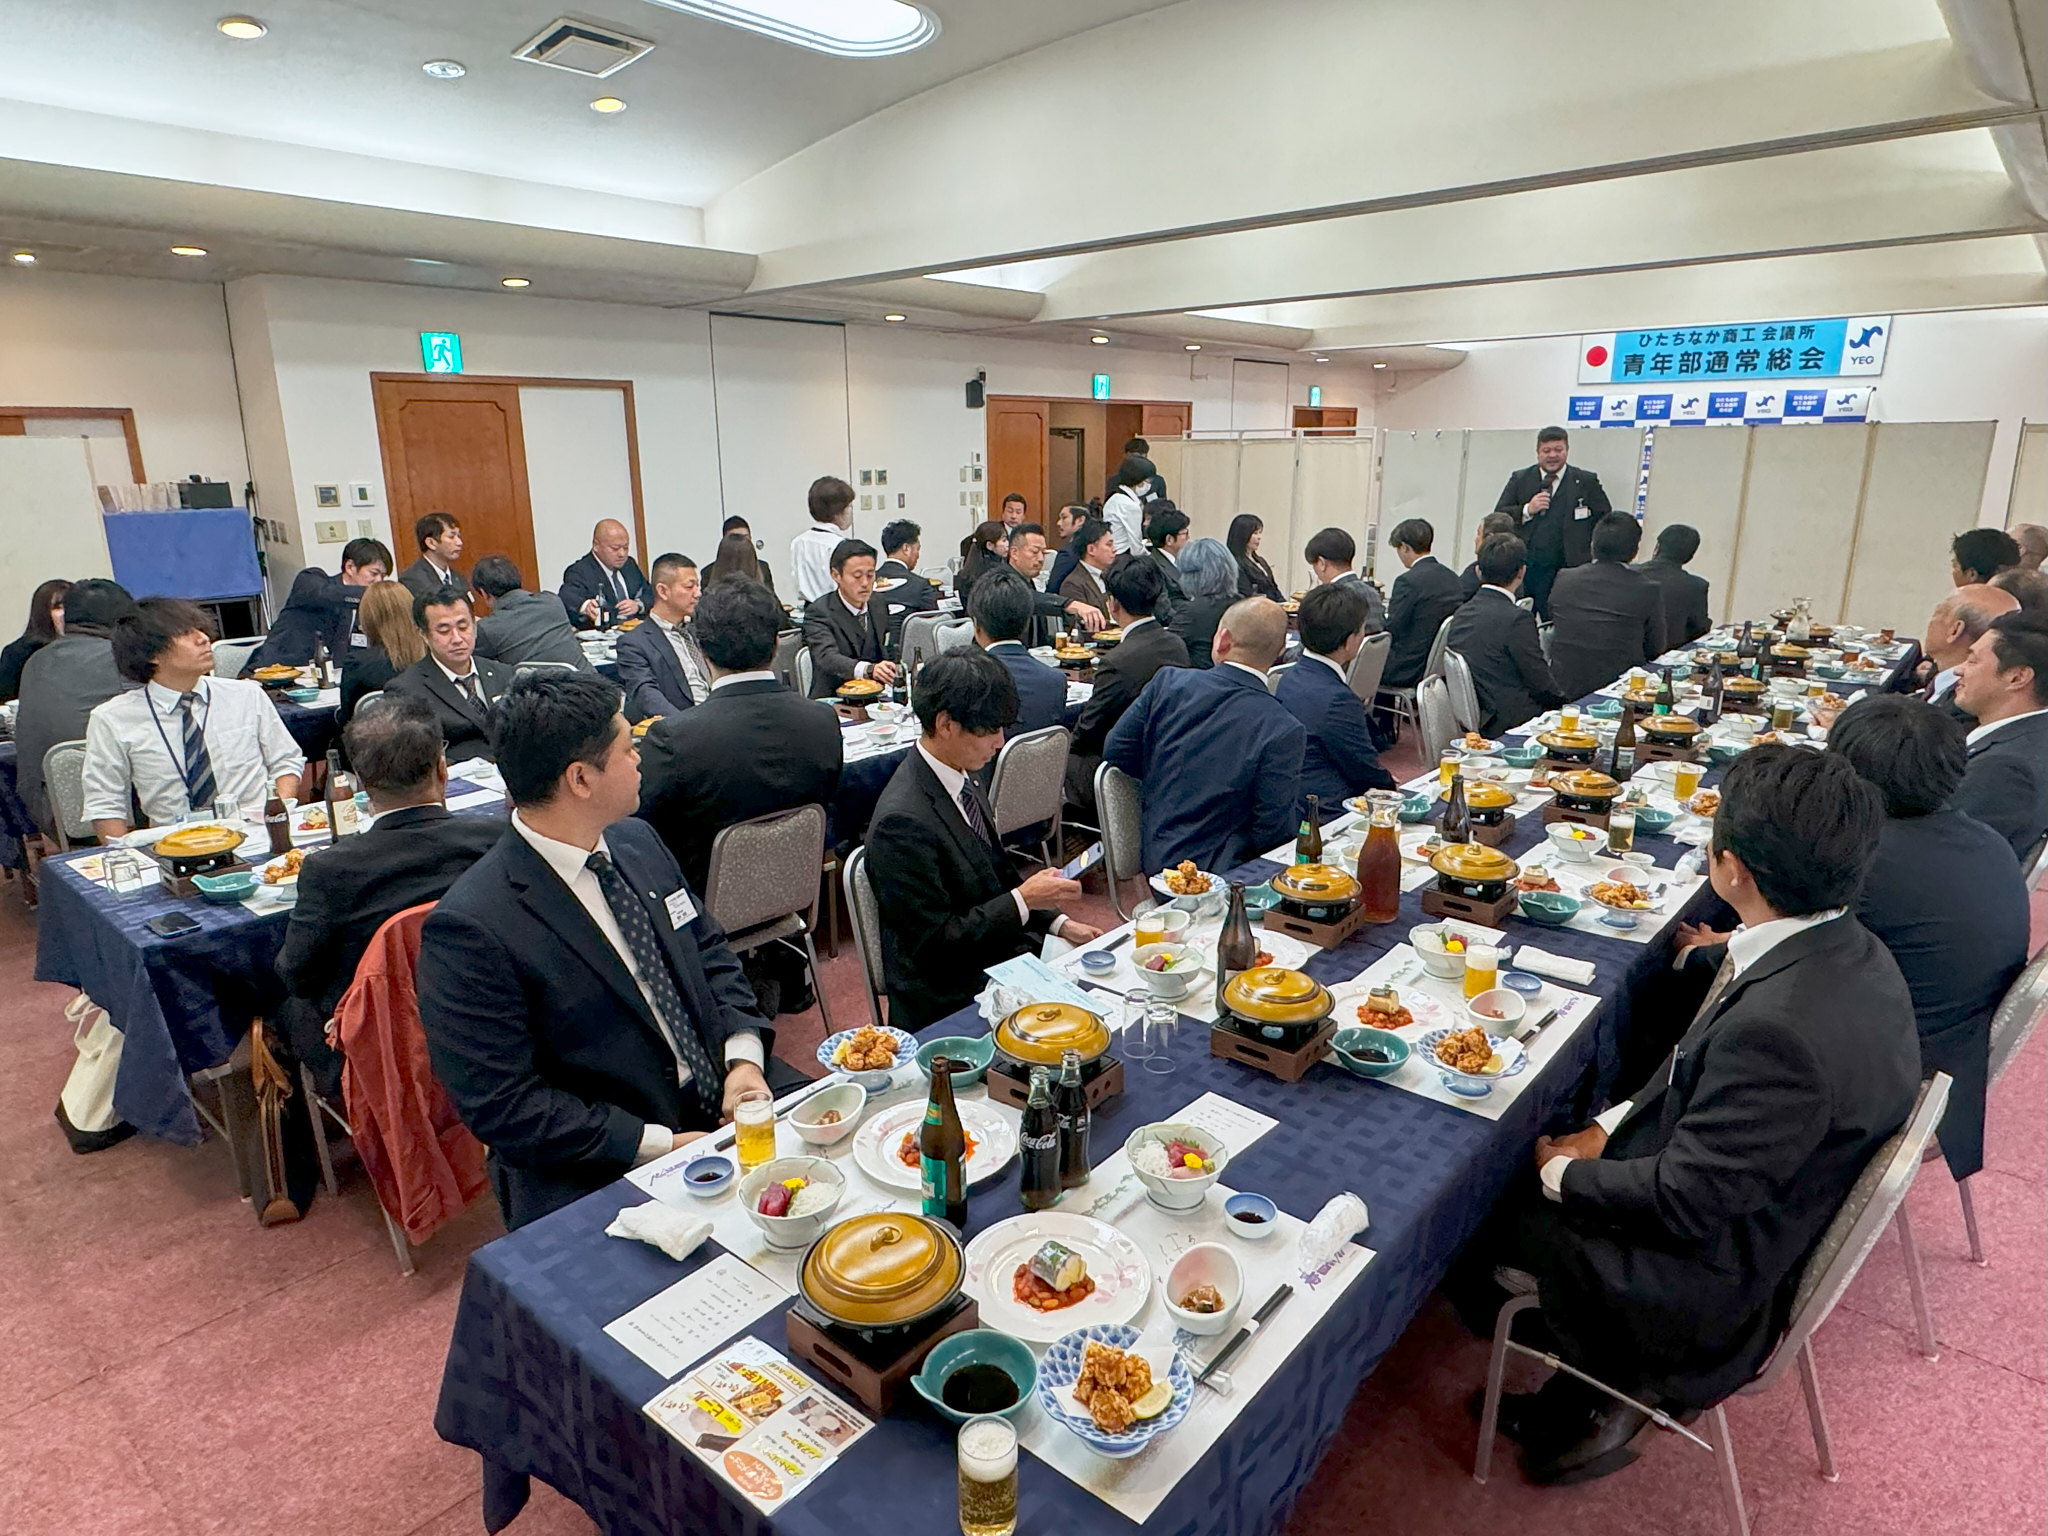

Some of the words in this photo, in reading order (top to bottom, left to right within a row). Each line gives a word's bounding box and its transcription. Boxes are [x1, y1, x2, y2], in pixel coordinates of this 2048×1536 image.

[1639, 325, 1815, 347] ひたちなか商工会議所
[1623, 346, 1825, 376] 青年部通常総会
[1851, 356, 1874, 364] YEG
